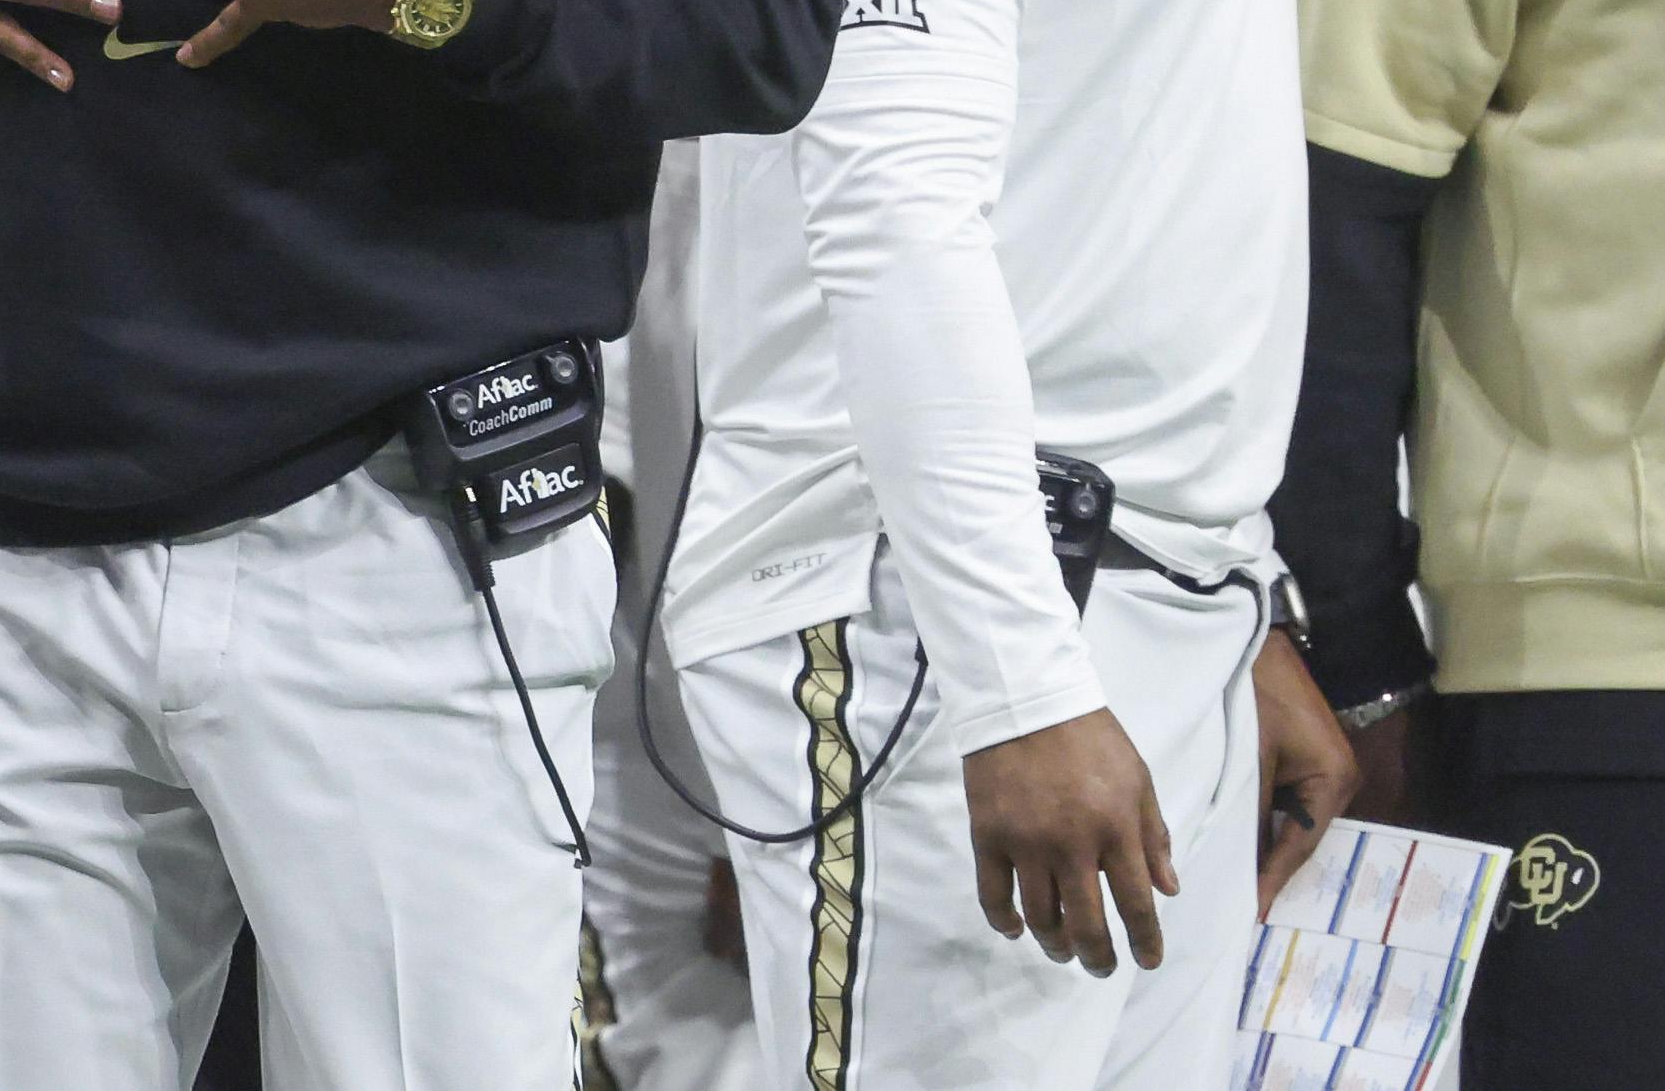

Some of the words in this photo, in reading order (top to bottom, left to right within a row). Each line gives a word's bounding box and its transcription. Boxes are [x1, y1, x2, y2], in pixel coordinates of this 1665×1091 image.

[477, 374, 539, 409] Aflac
[469, 397, 554, 437] CoachComm
[500, 464, 584, 514] Aflac
[751, 552, 828, 582] DRI-FIT
[1520, 846, 1568, 905] CU
